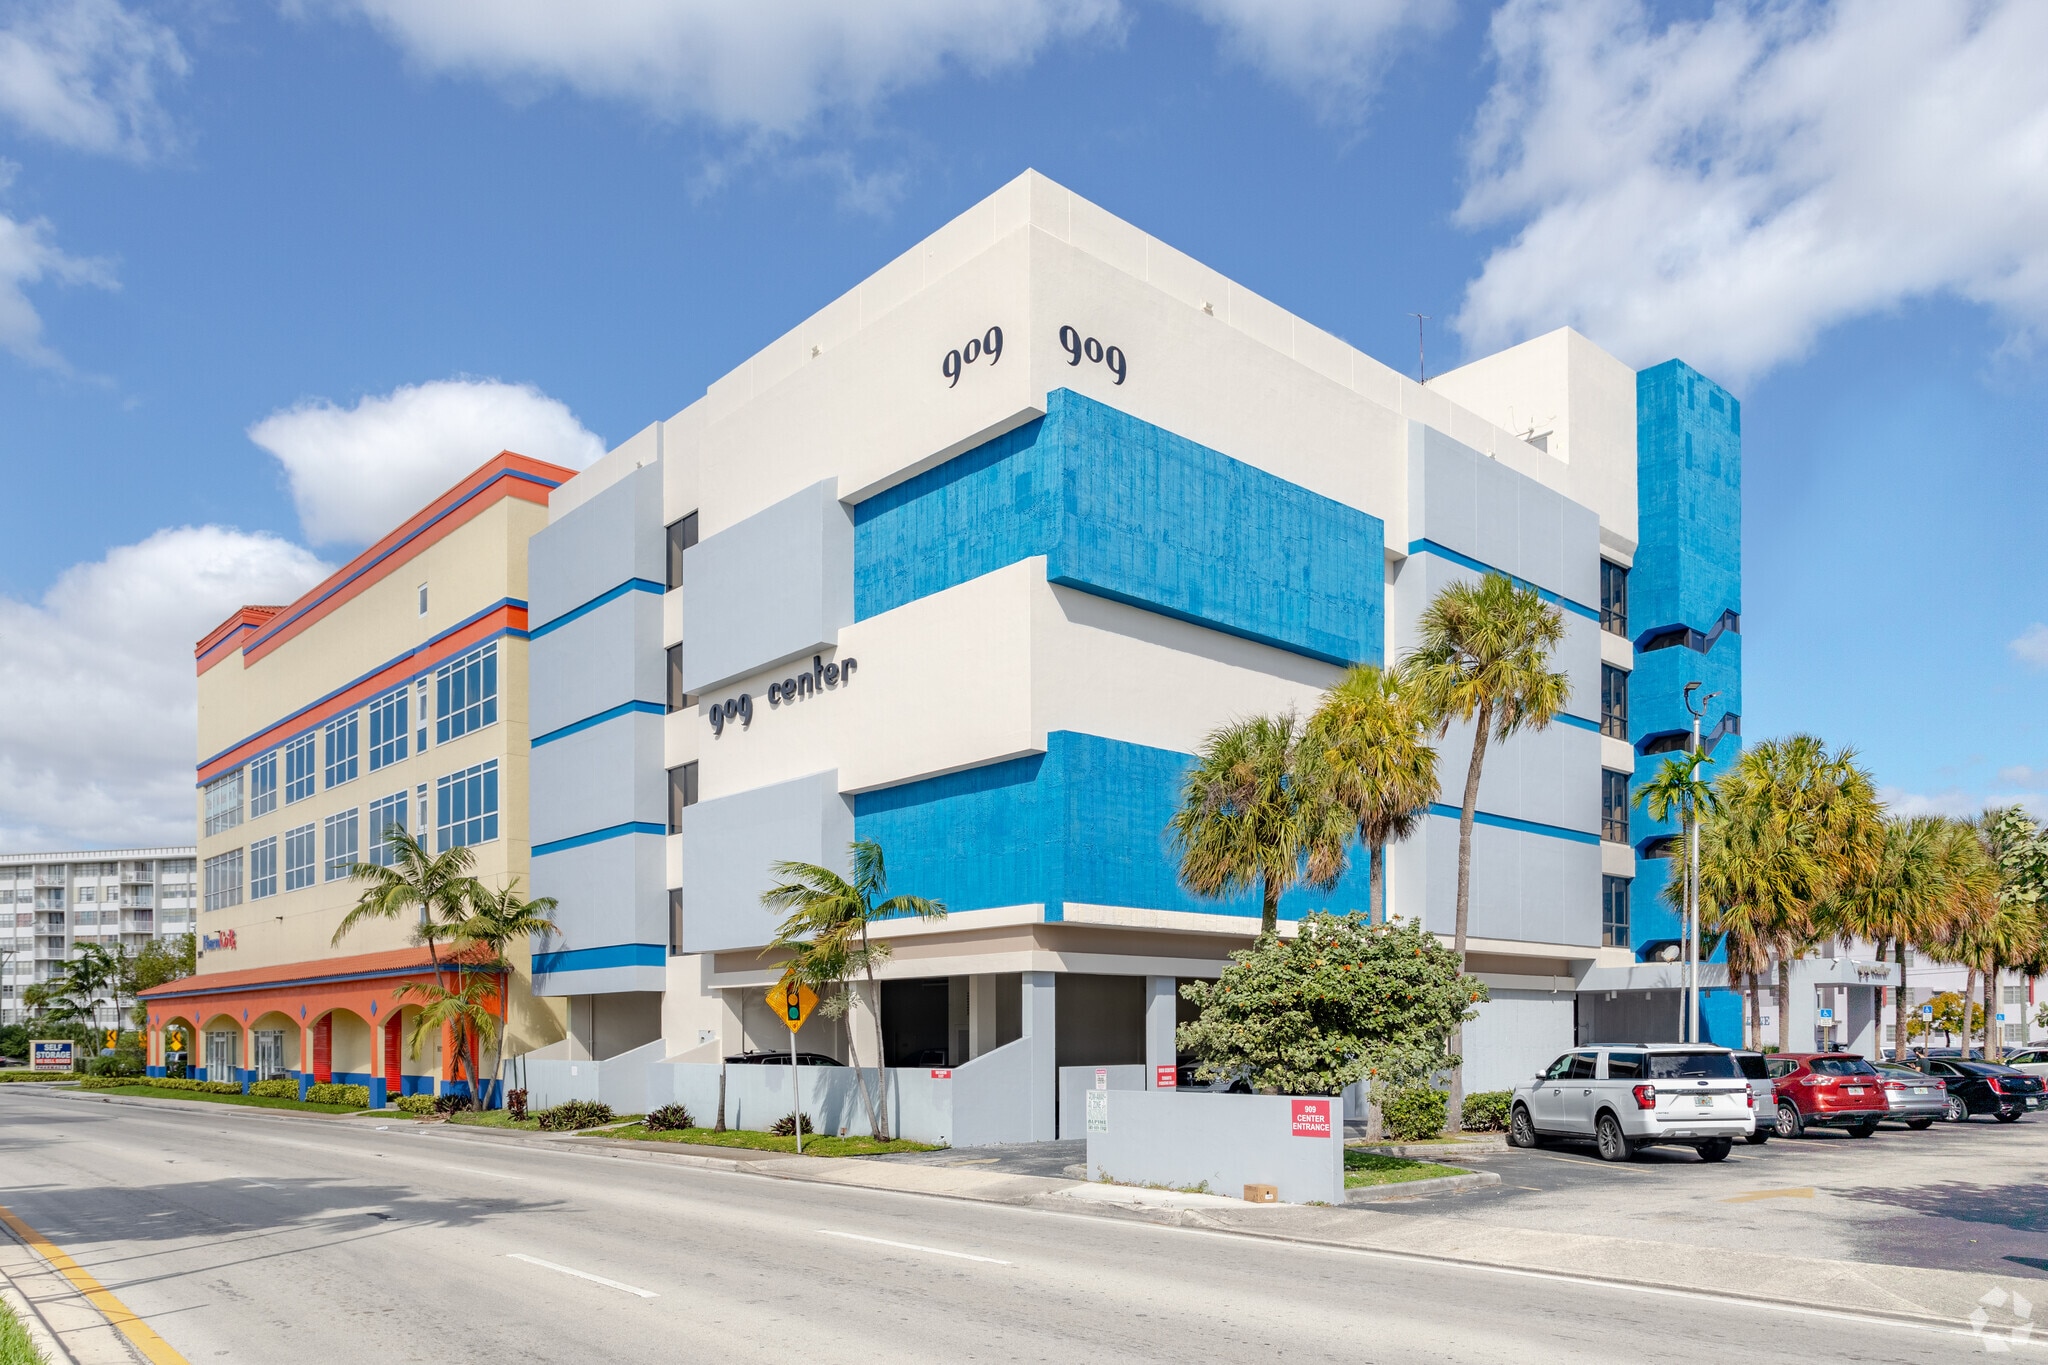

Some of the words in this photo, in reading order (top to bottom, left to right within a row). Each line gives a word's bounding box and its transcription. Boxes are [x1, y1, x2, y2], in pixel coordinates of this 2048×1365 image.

[942, 326, 1004, 388] 909
[1059, 325, 1127, 386] 909
[709, 693, 753, 736] 909
[767, 655, 858, 705] center
[44, 1043, 63, 1051] SELF
[35, 1051, 71, 1059] STORAGE
[1304, 1105, 1317, 1113] 909
[1296, 1114, 1325, 1123] CENTER
[1292, 1122, 1330, 1132] ENTRANCE
